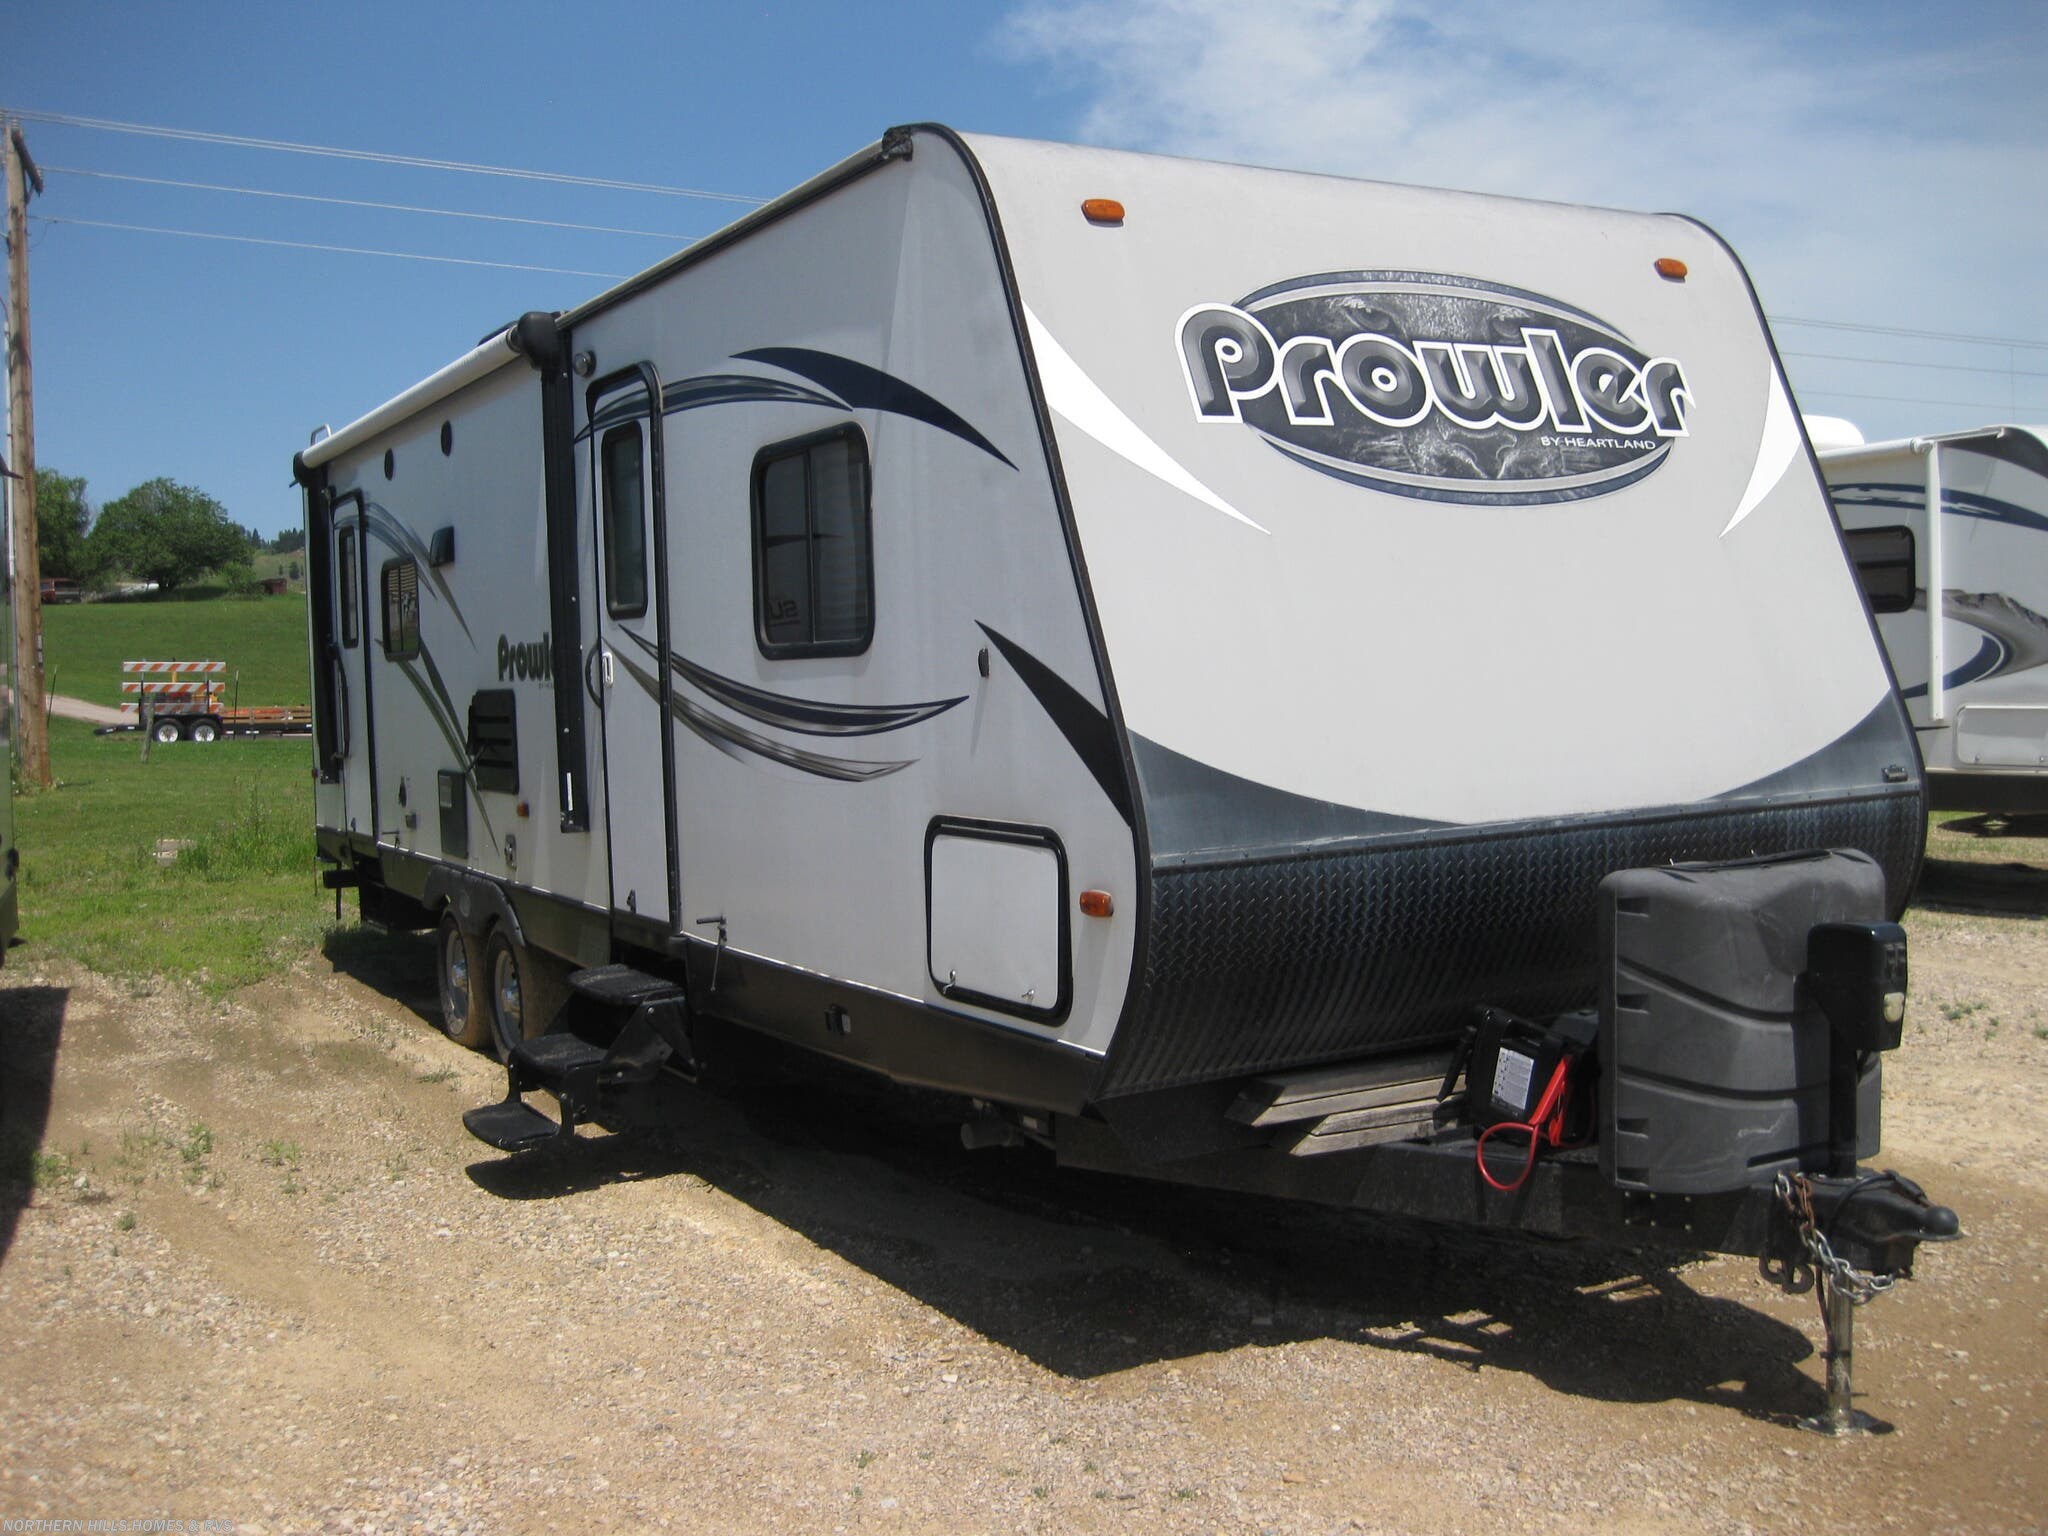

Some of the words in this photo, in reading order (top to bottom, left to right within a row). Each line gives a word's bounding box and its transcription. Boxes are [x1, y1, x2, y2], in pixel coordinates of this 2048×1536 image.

[1174, 302, 1696, 437] Prowler
[1540, 436, 1560, 447] BY
[1564, 437, 1656, 450] HEARTLAND
[497, 632, 554, 682] Prowl
